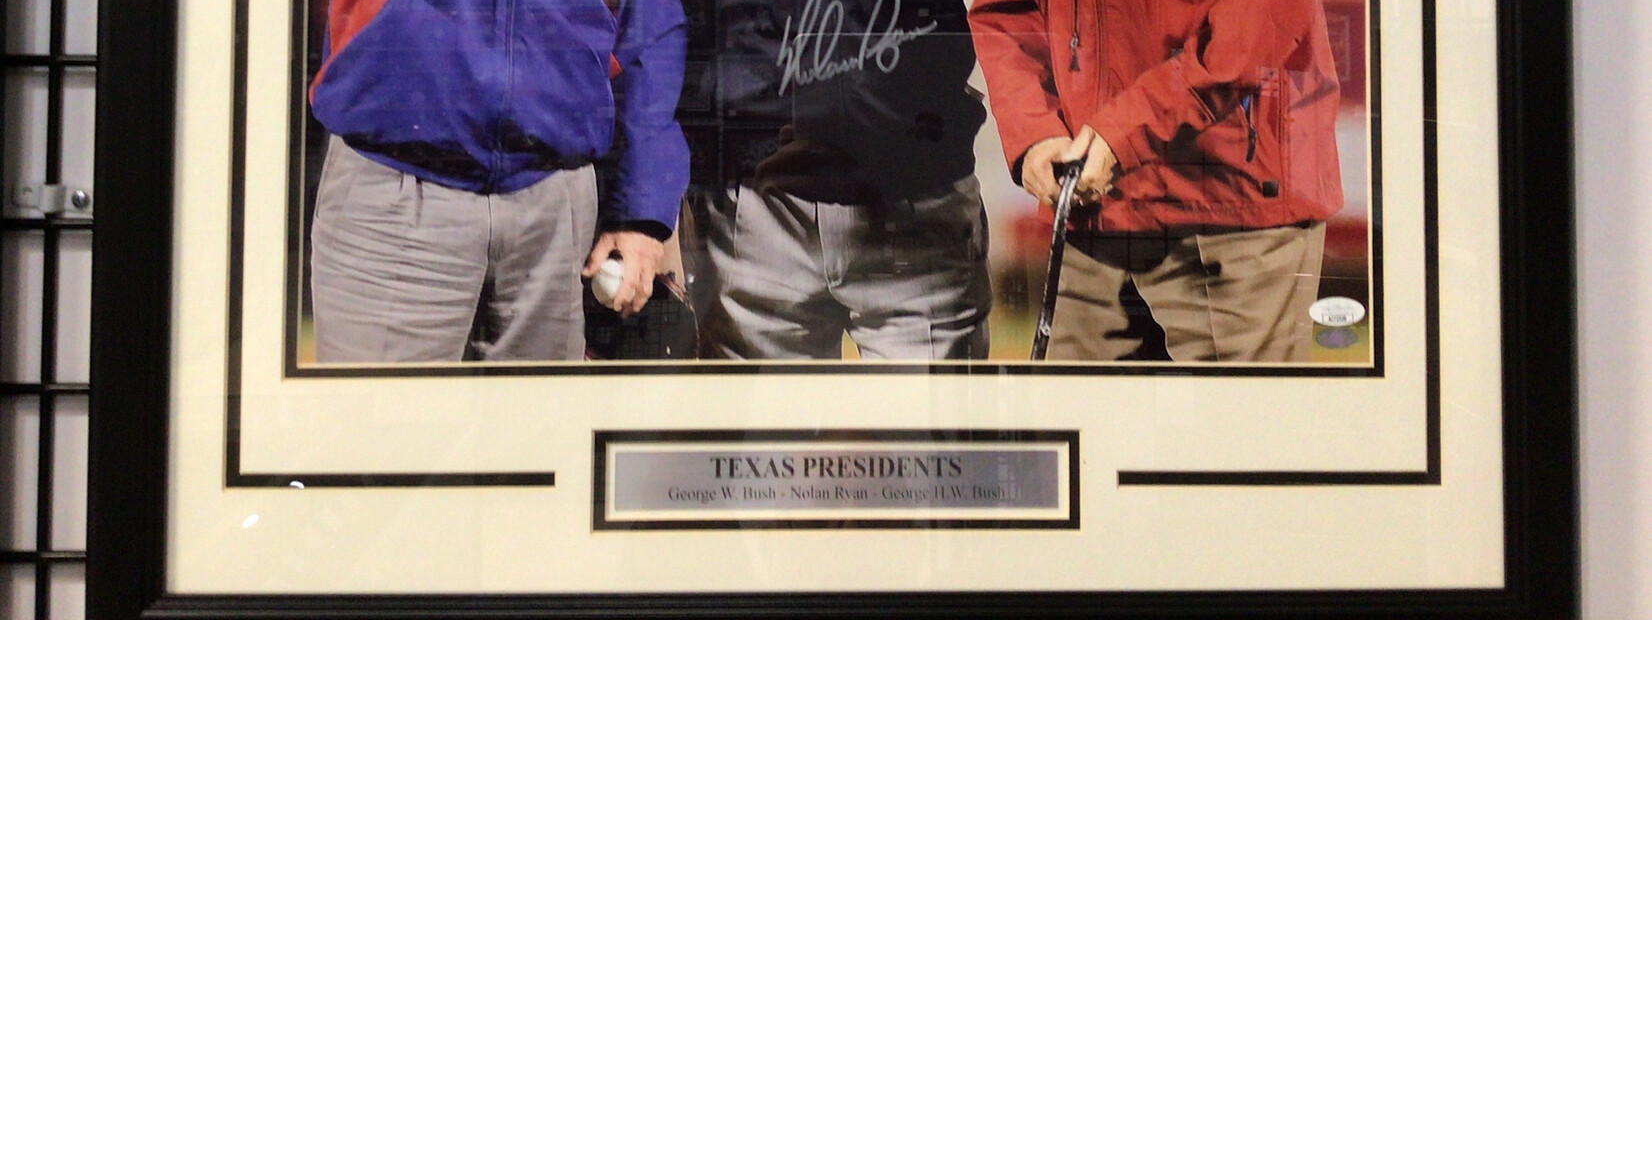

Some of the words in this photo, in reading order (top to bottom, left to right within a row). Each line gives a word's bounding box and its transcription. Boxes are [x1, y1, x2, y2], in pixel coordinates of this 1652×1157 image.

[709, 456, 795, 480] TEXAS
[803, 456, 963, 479] PRESIDENTS
[668, 487, 718, 504] George
[720, 487, 739, 501] W.
[743, 486, 777, 501] Bush
[790, 487, 831, 501] Nolan
[834, 487, 868, 504] Ryan
[882, 487, 931, 504] George
[972, 486, 1006, 501] Bush
